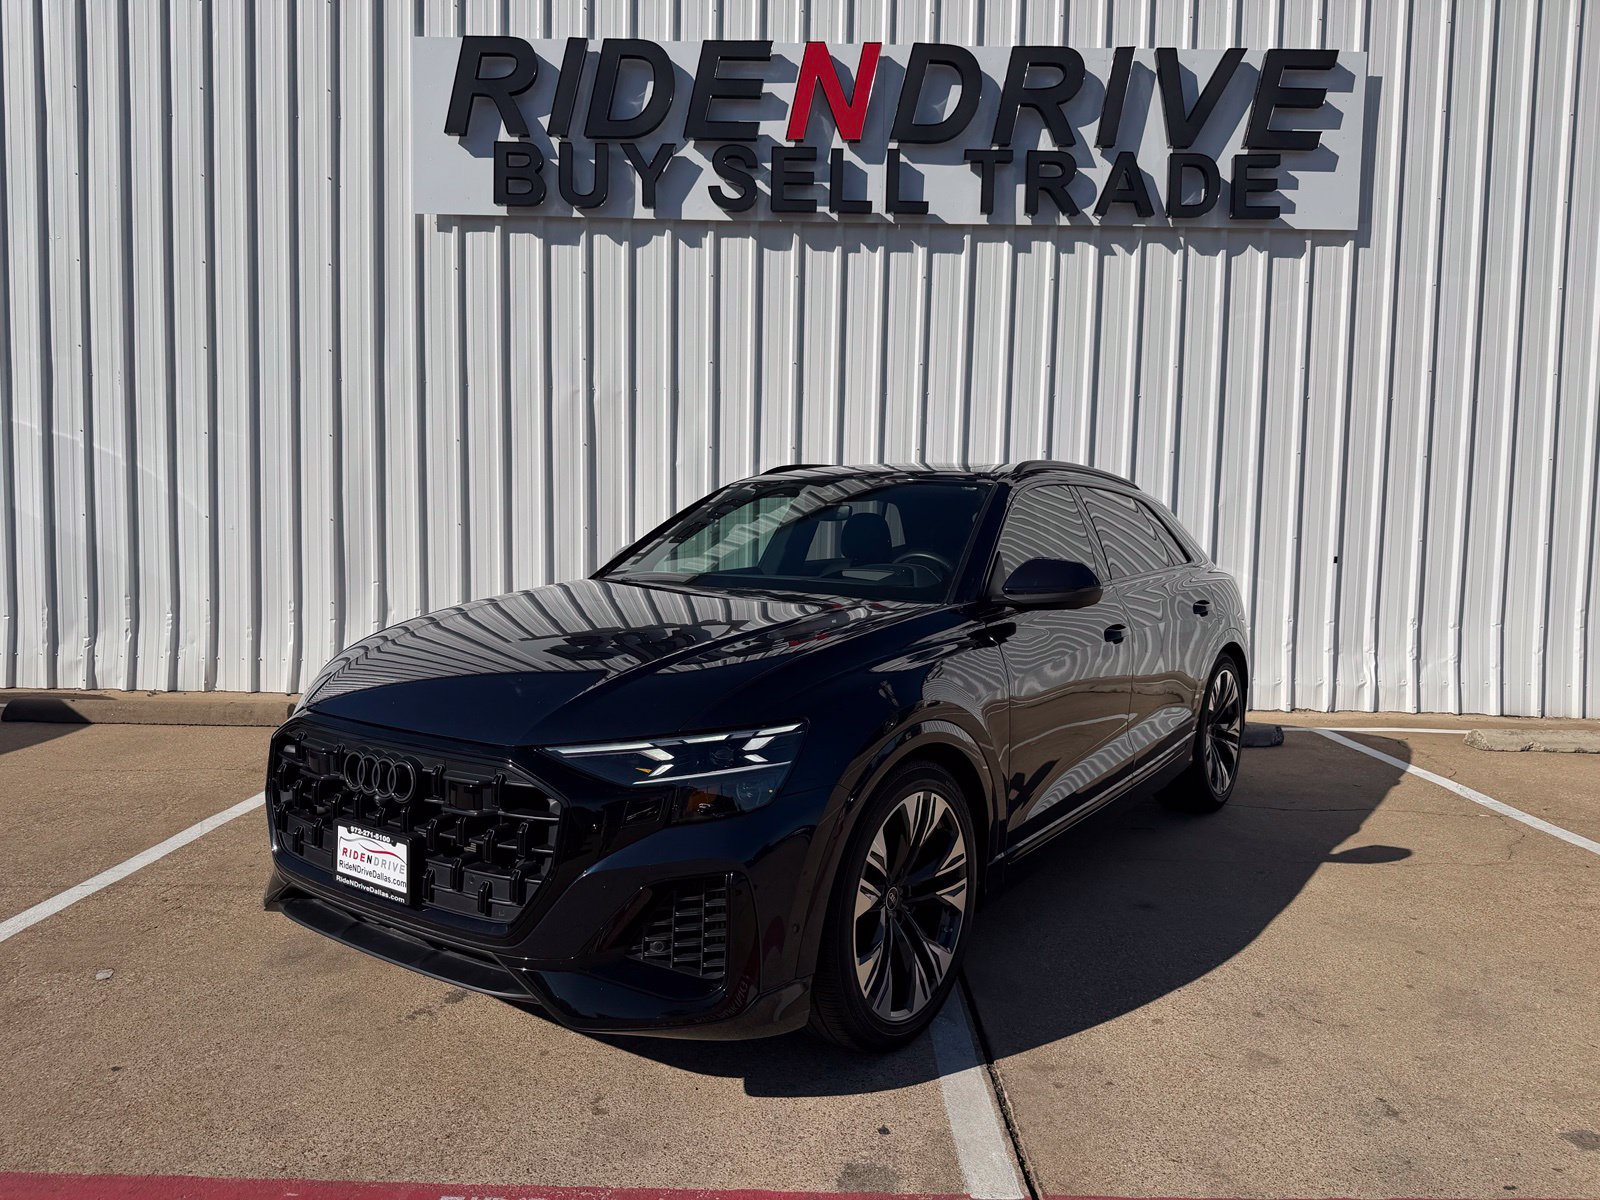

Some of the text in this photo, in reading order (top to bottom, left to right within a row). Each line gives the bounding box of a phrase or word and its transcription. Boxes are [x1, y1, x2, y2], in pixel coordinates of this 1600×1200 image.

[493, 140, 1282, 220] BUY SELL TRADE
[338, 859, 407, 888] RideNDriveDallas.com
[335, 874, 405, 903] RideNDriveDallas.com
